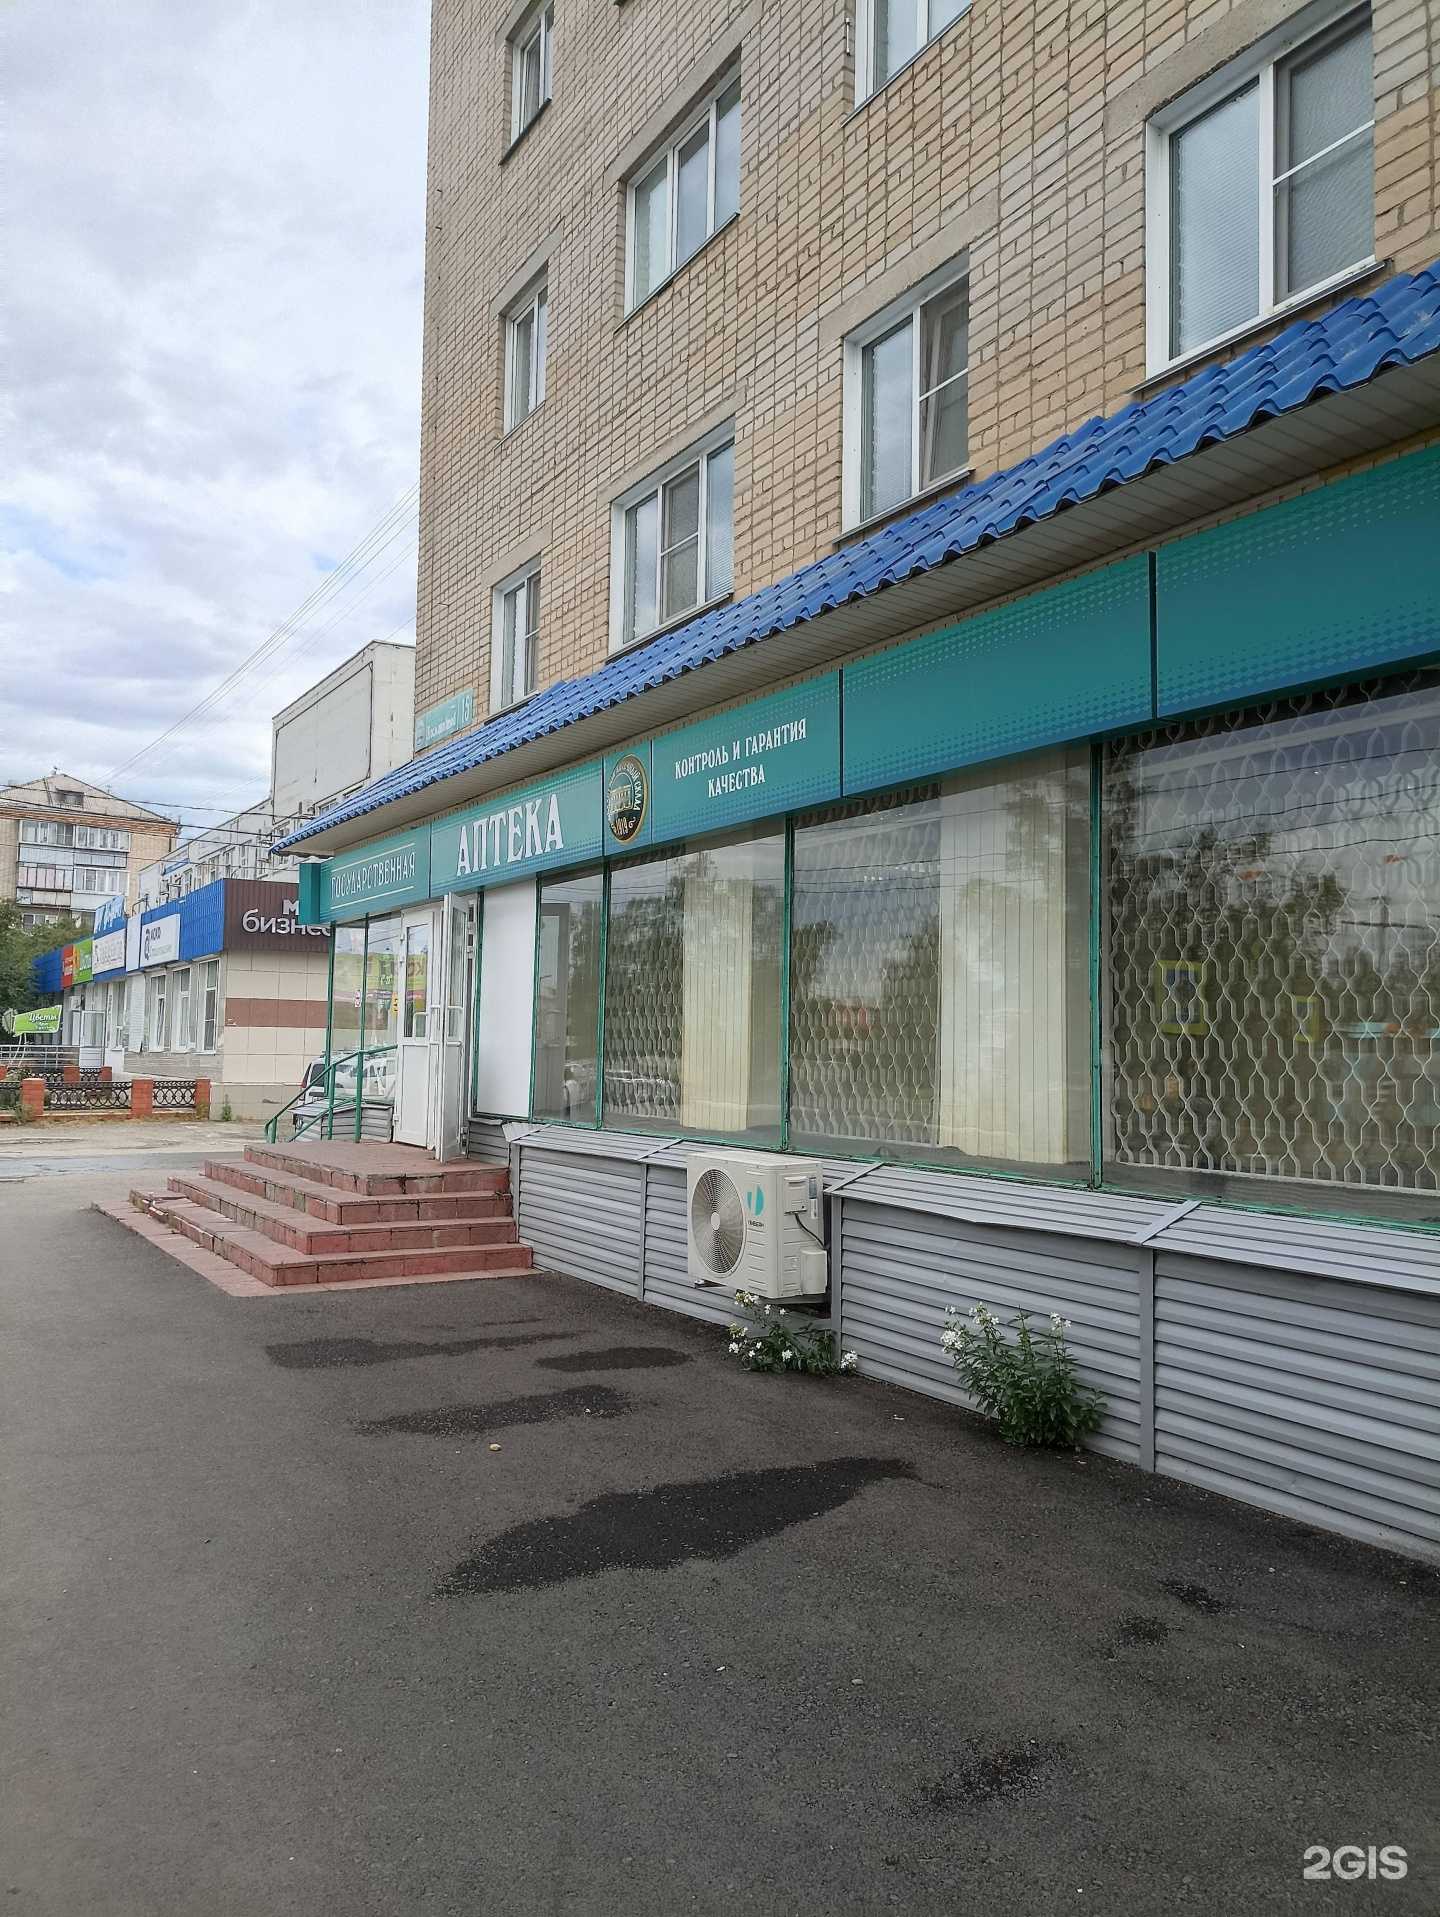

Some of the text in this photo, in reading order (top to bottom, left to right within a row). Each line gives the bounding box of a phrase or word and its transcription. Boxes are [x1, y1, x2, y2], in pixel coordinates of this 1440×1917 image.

[675, 745, 729, 780] КОНТРОЛЬ
[732, 740, 741, 761] И
[745, 718, 806, 757] ГАРАНТИЯ
[708, 764, 766, 798] КАЧЕСТВА
[456, 793, 564, 877] АПТЕКА
[331, 851, 416, 899] ГОСУДАРСТВЕННАЯ
